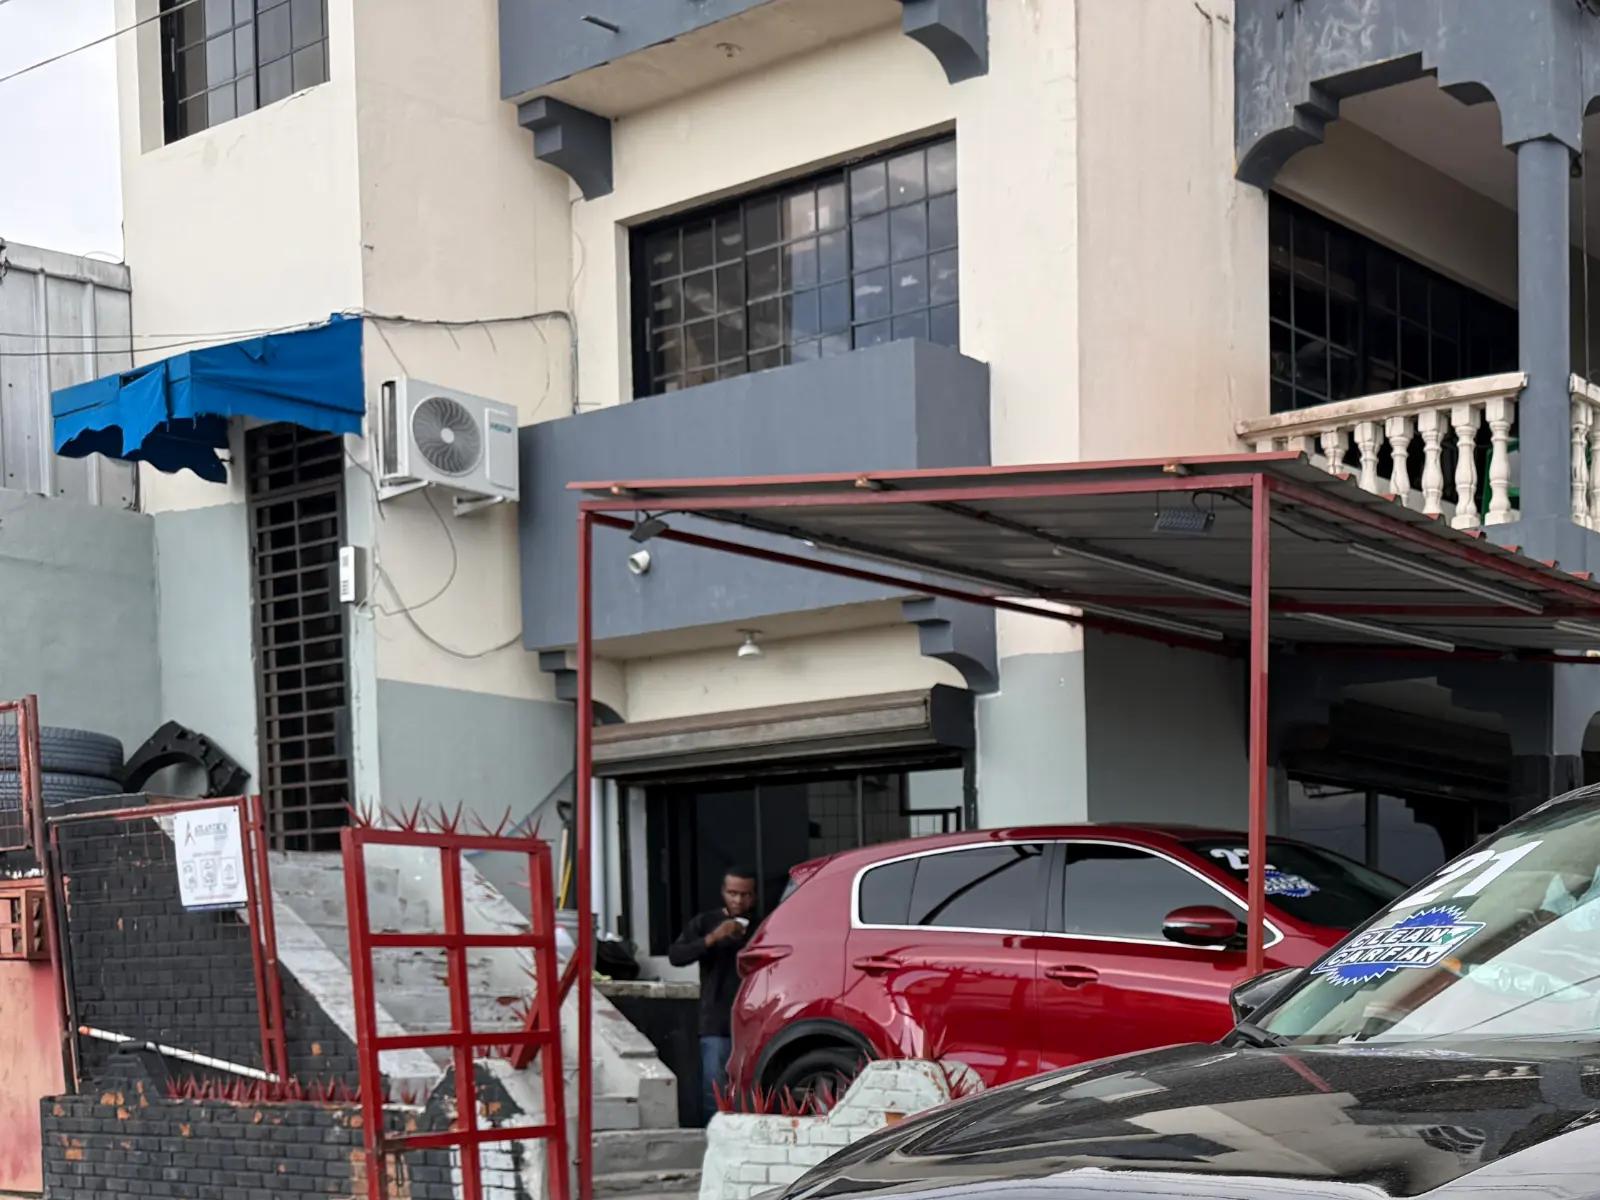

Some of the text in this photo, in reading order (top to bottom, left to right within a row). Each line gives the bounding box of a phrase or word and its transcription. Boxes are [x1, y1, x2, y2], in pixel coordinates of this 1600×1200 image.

[1388, 840, 1545, 912] 21
[1350, 926, 1452, 949] CLEAN
[1328, 945, 1440, 967] CARFAX
